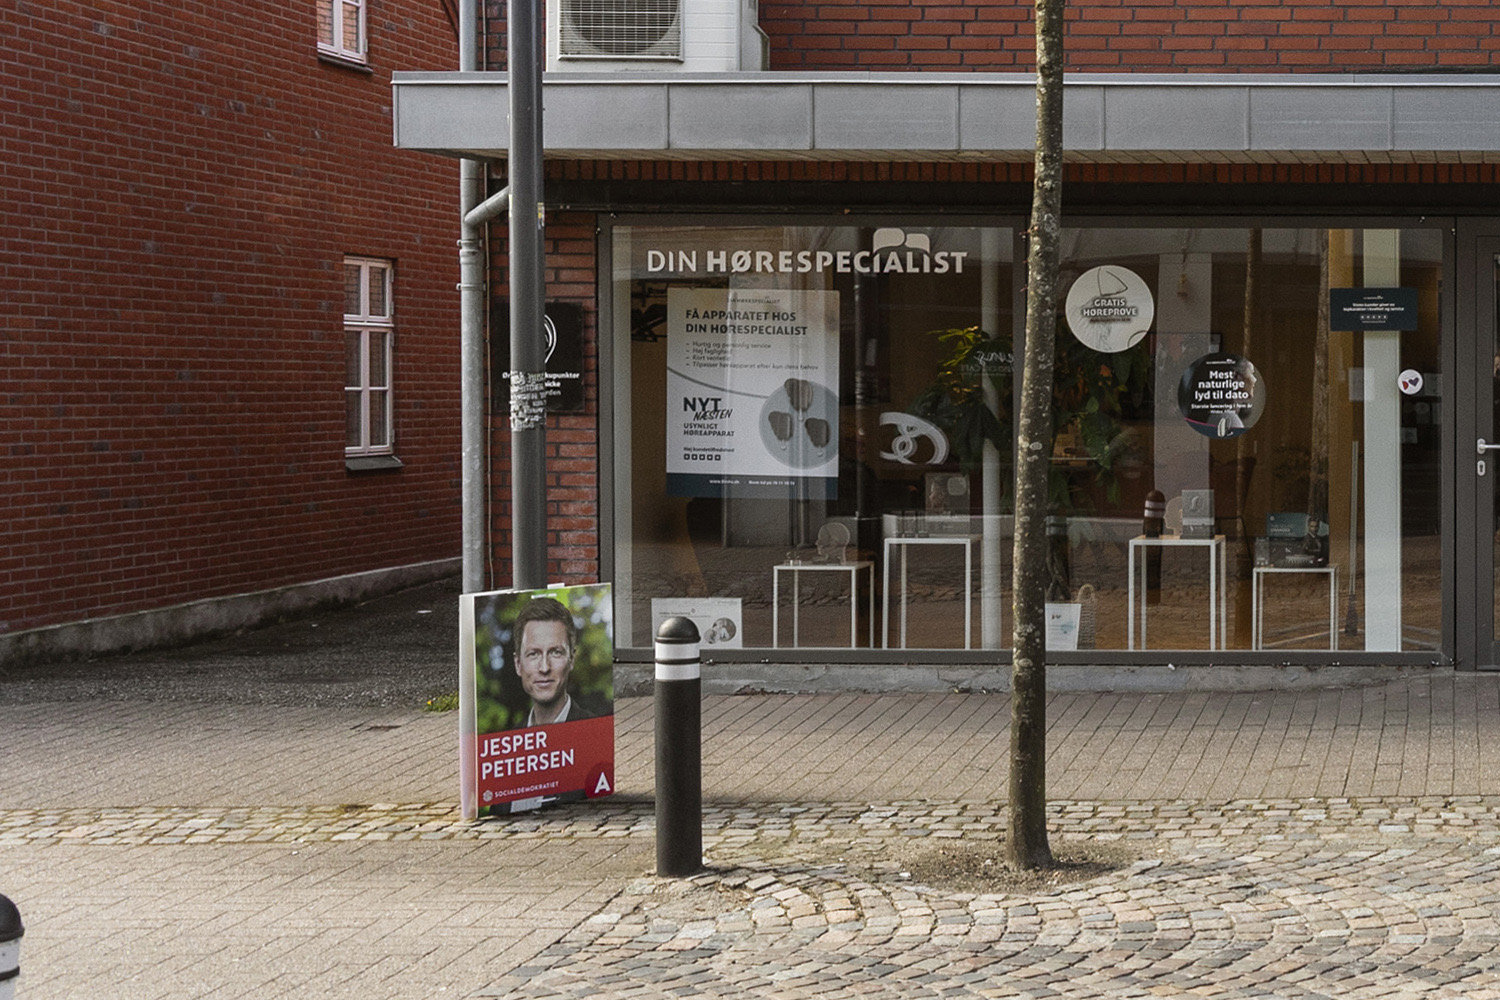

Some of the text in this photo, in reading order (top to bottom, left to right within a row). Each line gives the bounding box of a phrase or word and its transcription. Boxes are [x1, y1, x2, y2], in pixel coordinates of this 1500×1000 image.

[648, 250, 968, 274] DIN HØRESPECIALIST
[1094, 299, 1125, 307] GRATIS
[686, 308, 796, 322] FÅ APPARATET HOS
[686, 324, 808, 336] DIN HØRESPECIALIST
[1209, 370, 1233, 379] Mest
[1198, 380, 1245, 390] naturlige
[1195, 391, 1249, 401] lyd til dato
[684, 397, 722, 412] NYT
[693, 408, 733, 422] NÆSTEN
[480, 731, 547, 757] JESPER
[482, 749, 574, 780] PETERSEN
[494, 781, 559, 798] SOCIALDEMOKRATIET
[594, 772, 610, 793] A
